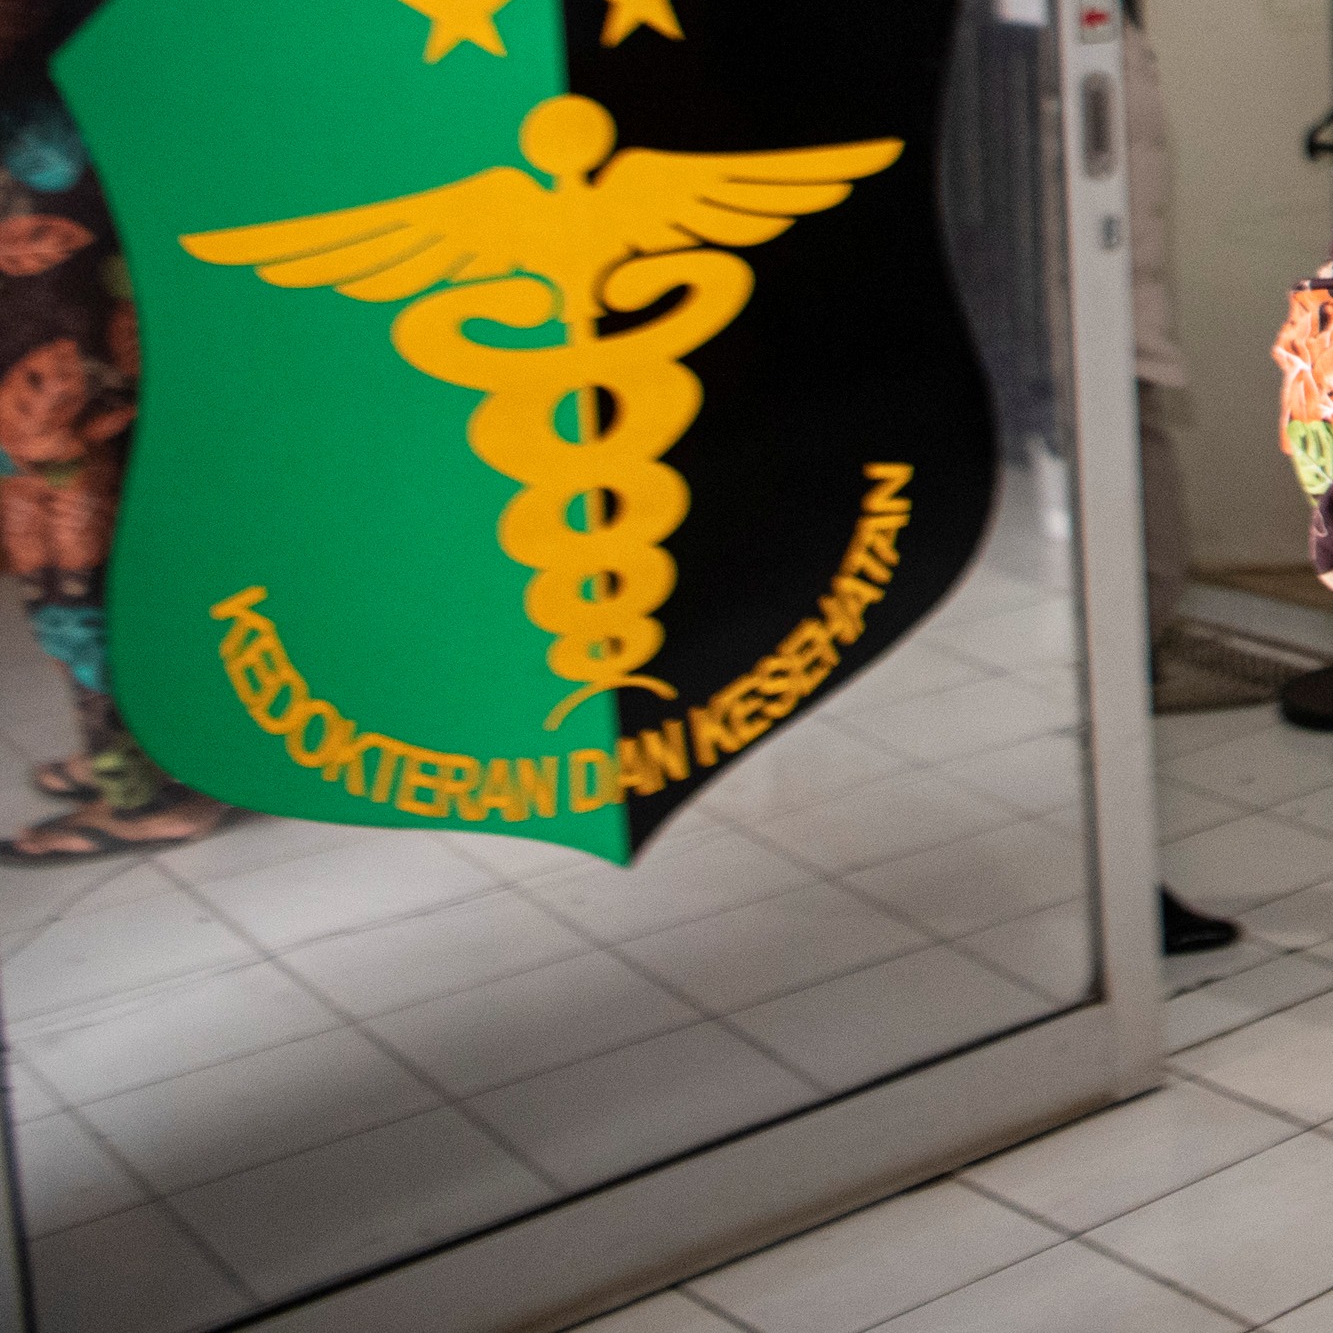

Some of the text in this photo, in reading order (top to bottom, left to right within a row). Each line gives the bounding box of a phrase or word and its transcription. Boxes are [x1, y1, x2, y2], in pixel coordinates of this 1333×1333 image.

[209, 462, 914, 822] KEDOKTERAN DAN KESEHATAN
